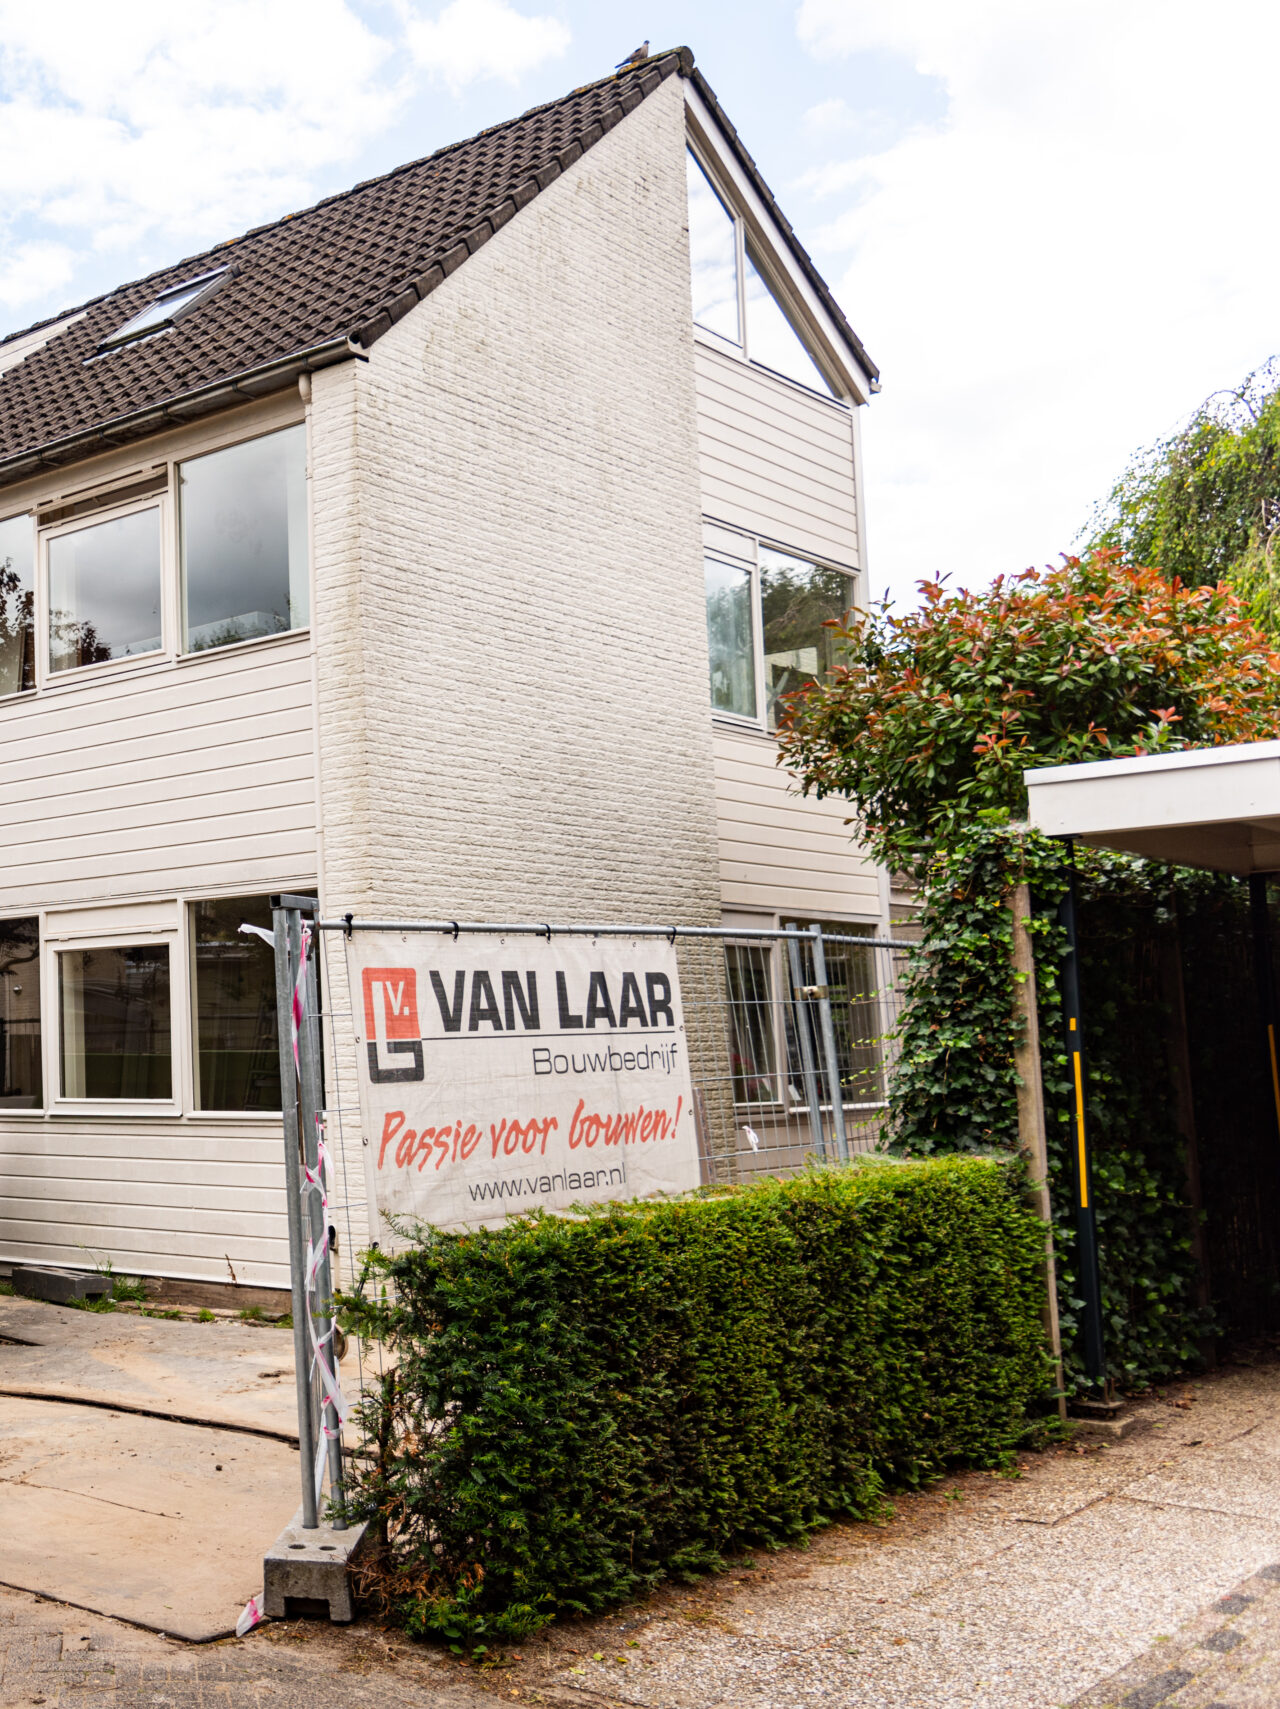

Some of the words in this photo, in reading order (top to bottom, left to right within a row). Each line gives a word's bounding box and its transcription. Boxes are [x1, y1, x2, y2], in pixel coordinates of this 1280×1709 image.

[429, 970, 540, 1033] VAN
[556, 971, 675, 1029] LAAR
[533, 1043, 678, 1076] Bouwbedrijf
[378, 1111, 483, 1172] Passie
[491, 1112, 558, 1159] voor
[569, 1096, 683, 1150] bouwen!
[468, 1163, 627, 1202] www.vanlaar.nl
